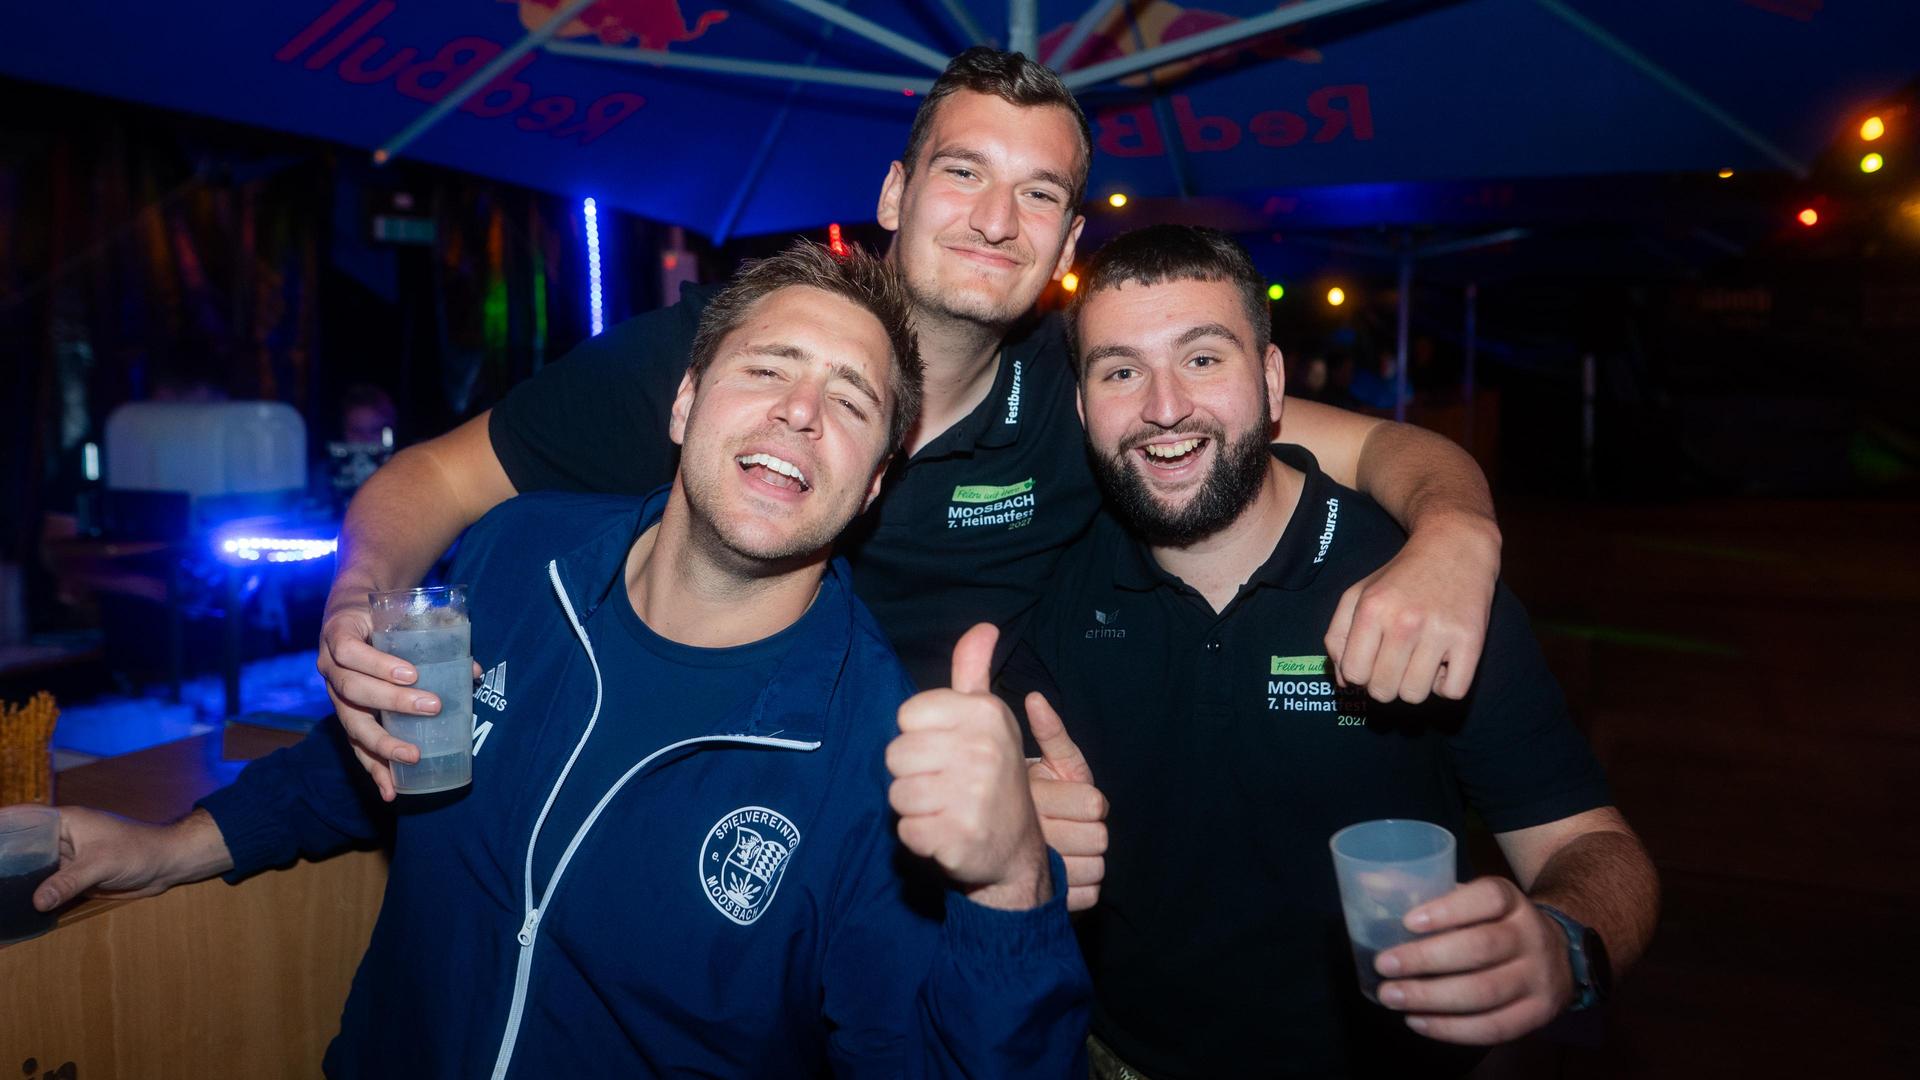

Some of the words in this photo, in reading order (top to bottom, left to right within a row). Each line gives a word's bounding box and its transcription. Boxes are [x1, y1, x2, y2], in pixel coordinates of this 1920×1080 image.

[1005, 360, 1022, 424] Festbursch
[947, 520, 958, 529] 7.
[962, 508, 1034, 527] Heimatfest
[948, 493, 1035, 519] MOOSBACH
[1313, 498, 1339, 564] Festbursch
[1276, 660, 1306, 671] Feiern
[1267, 697, 1279, 710] 7.
[706, 875, 759, 921] MOOSBACH
